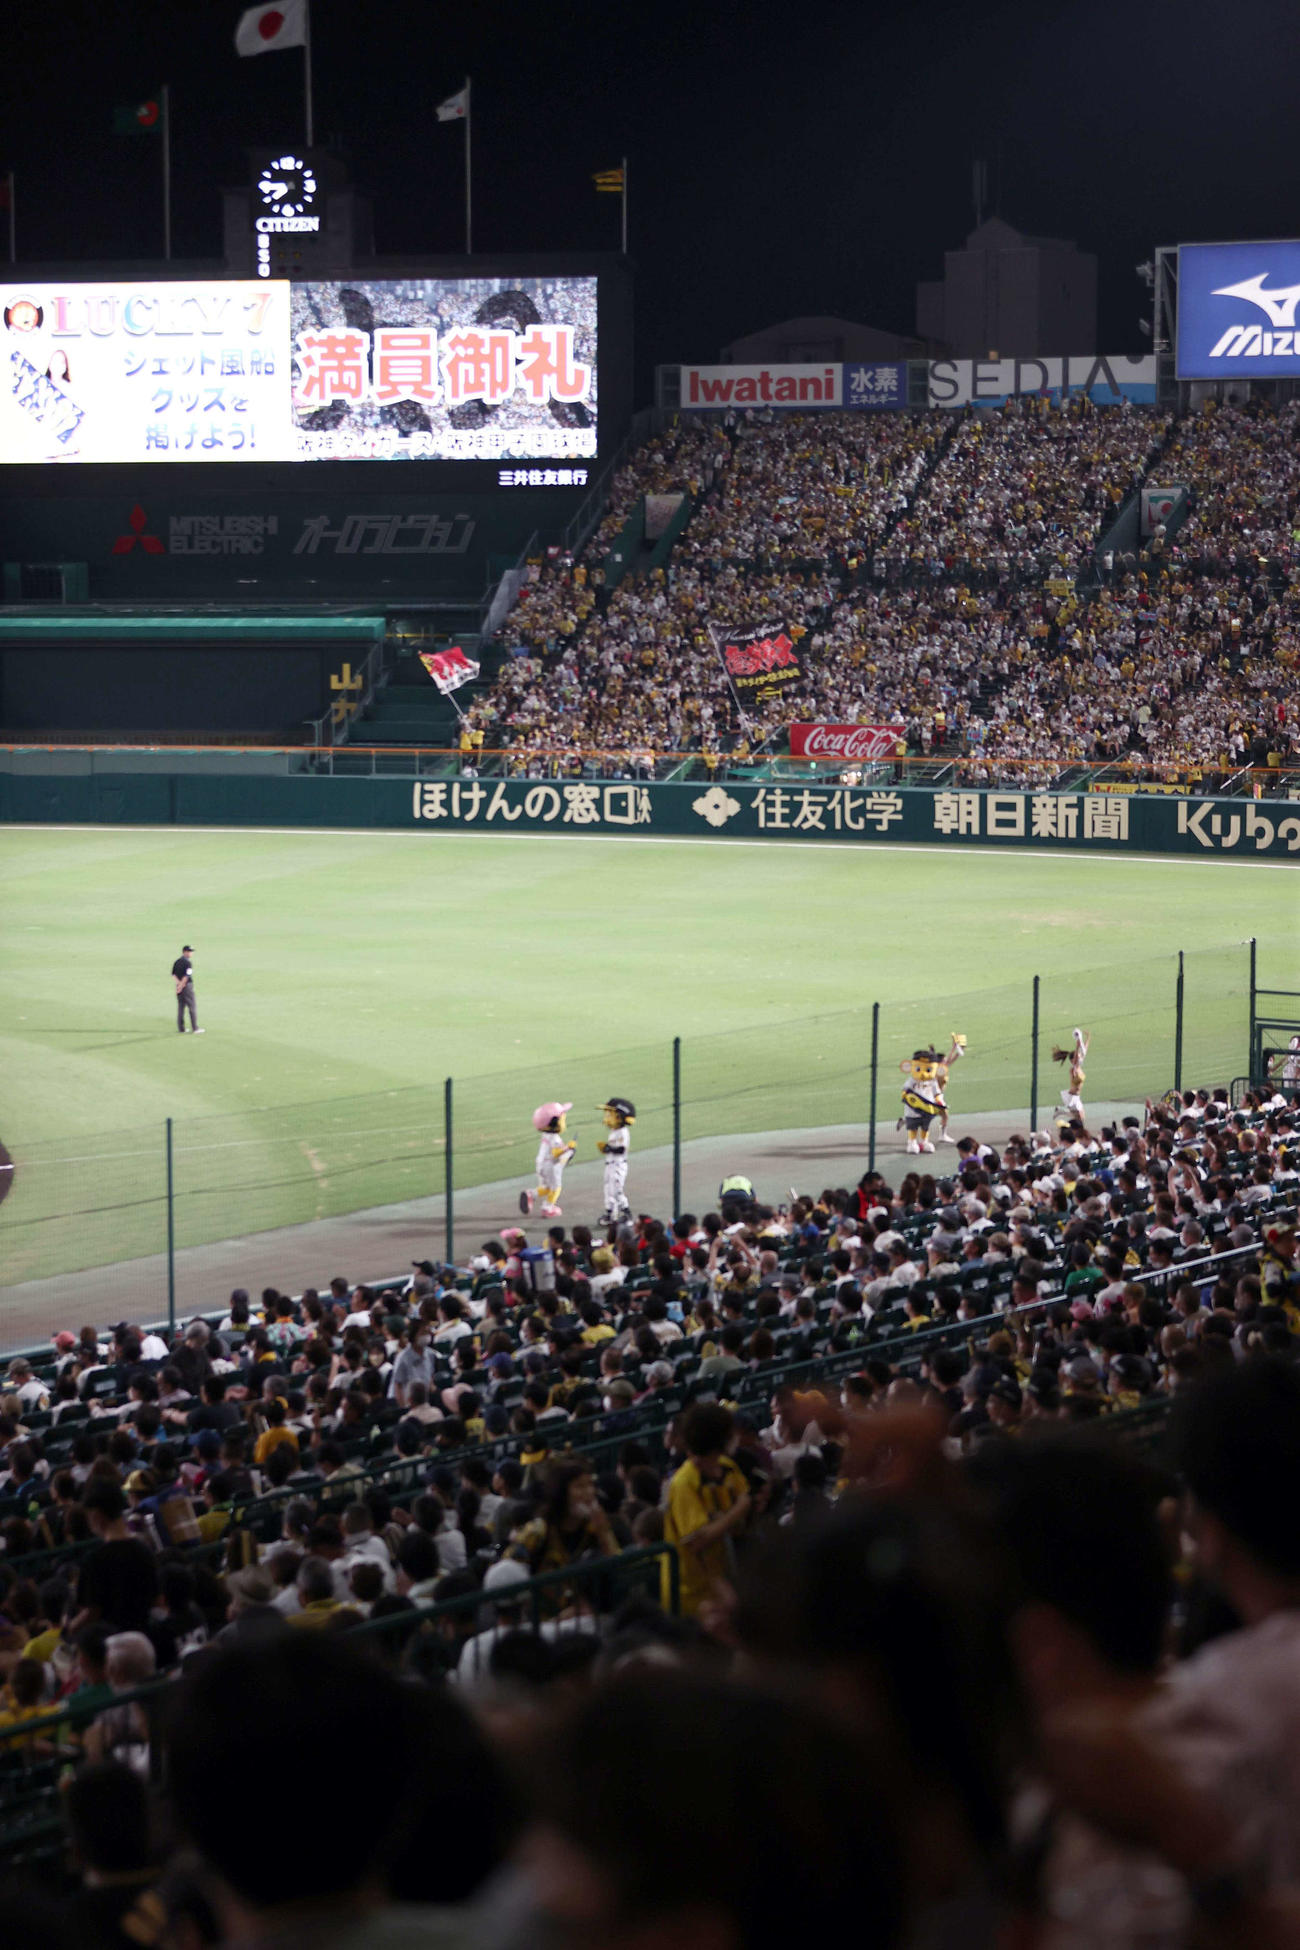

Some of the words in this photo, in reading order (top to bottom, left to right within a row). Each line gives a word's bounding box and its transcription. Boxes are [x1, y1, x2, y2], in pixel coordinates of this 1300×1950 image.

[256, 216, 319, 232] CITIZEN
[242, 292, 274, 336] 7
[299, 327, 588, 403] 満員御礼
[850, 367, 898, 392] 水素
[689, 368, 834, 403] Iwatani
[498, 469, 588, 486] 三井住友銀行
[169, 516, 278, 535] MITSUBISHI
[169, 535, 264, 555] ELECTRIC
[412, 781, 641, 825] ほけんの窓口
[750, 787, 904, 832] 住友化学
[933, 792, 1130, 841] 朝日新聞
